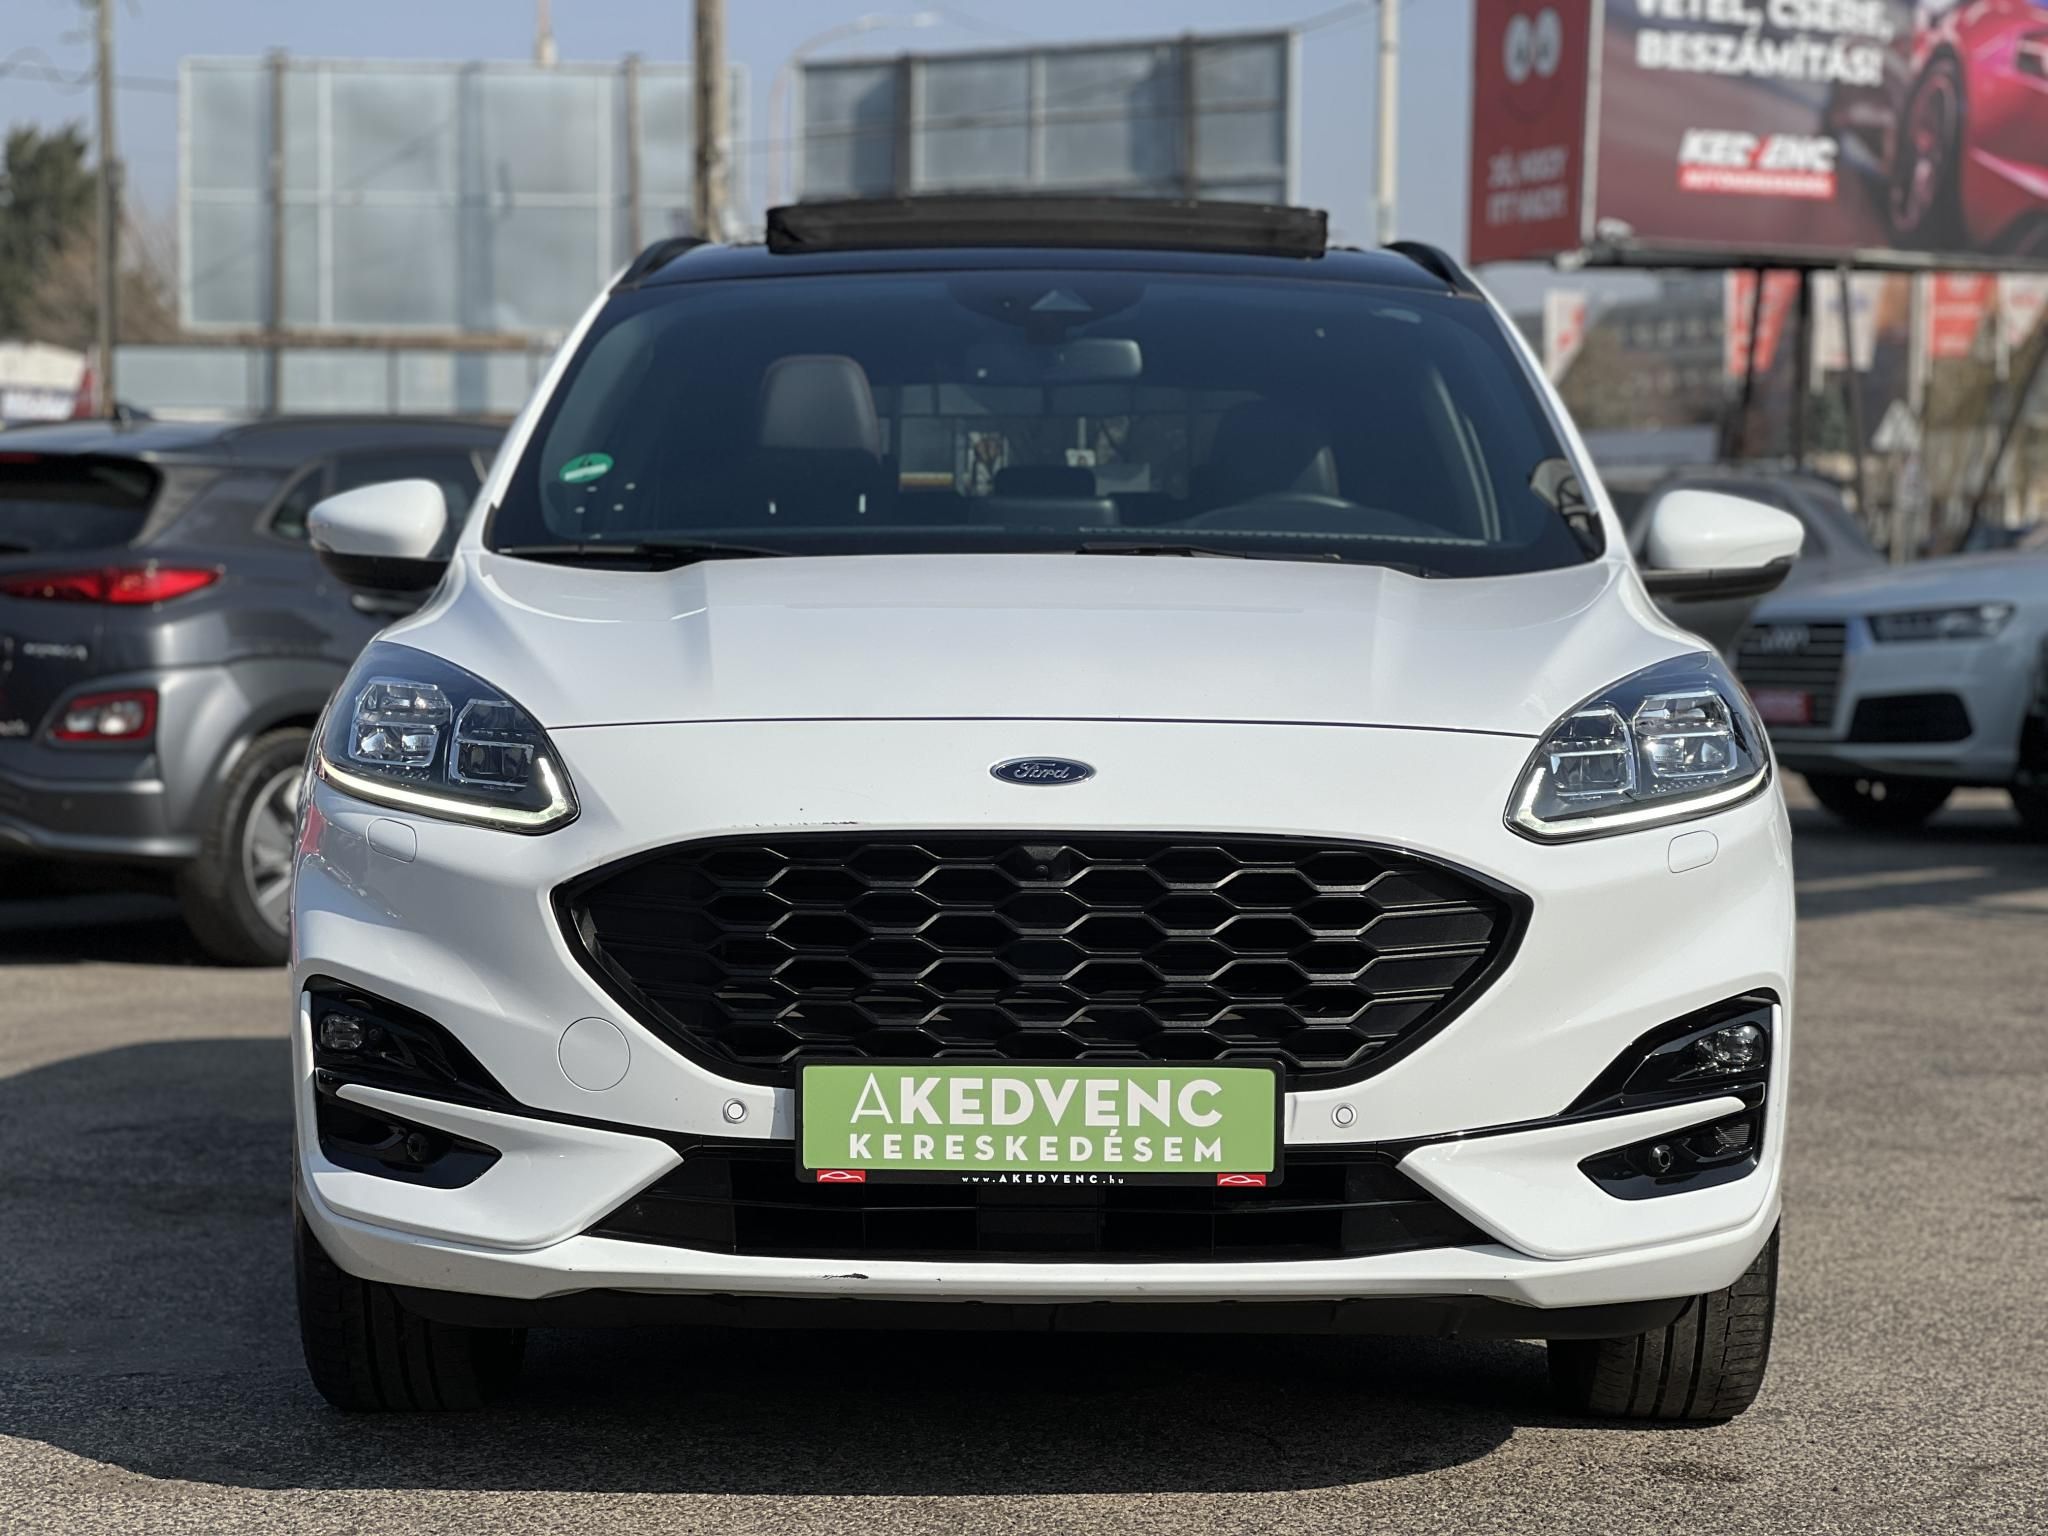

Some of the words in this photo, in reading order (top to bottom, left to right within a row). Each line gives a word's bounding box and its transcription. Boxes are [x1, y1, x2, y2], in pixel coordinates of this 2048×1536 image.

[1013, 761, 1070, 779] Ford
[850, 1128, 1222, 1163] KERESKEDÉSEM
[961, 1173, 1125, 1185] www.AKEDVENC.hu
